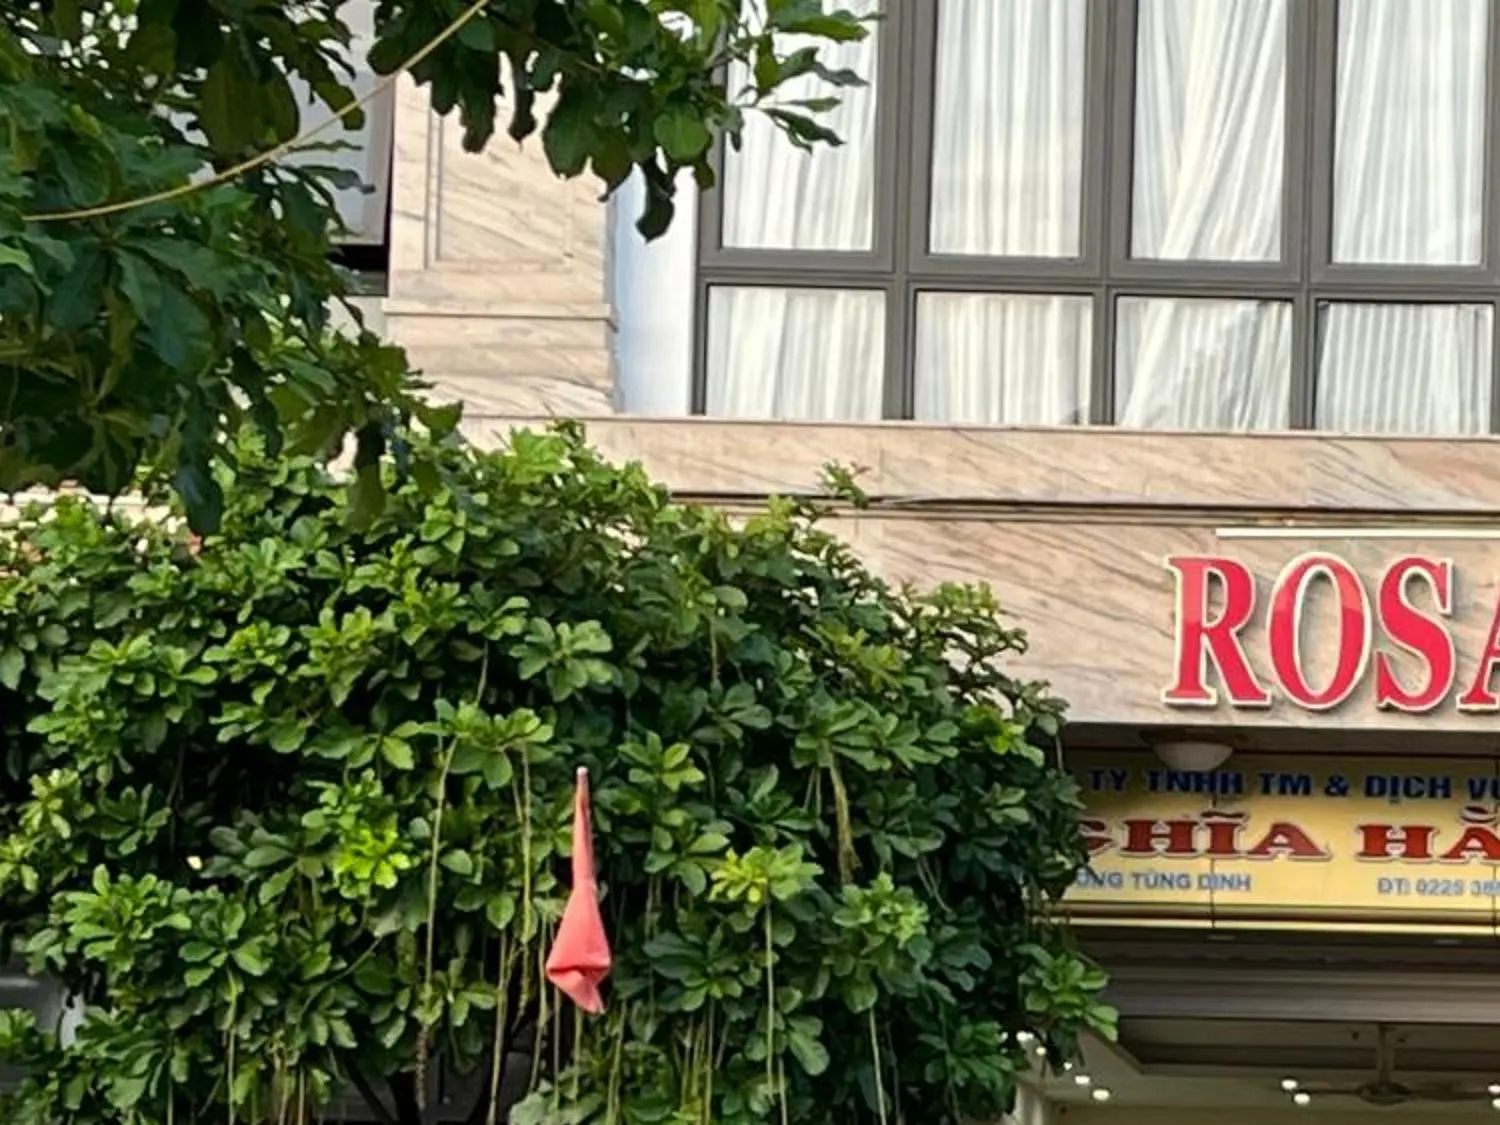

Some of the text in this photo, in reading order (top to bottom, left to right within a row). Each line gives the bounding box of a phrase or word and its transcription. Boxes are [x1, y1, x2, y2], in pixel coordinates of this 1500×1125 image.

[1088, 770, 1127, 792] TY
[1145, 770, 1244, 795] TNHH
[1258, 772, 1312, 796] TM
[1324, 774, 1349, 797] &
[1363, 774, 1452, 804] DỊCH
